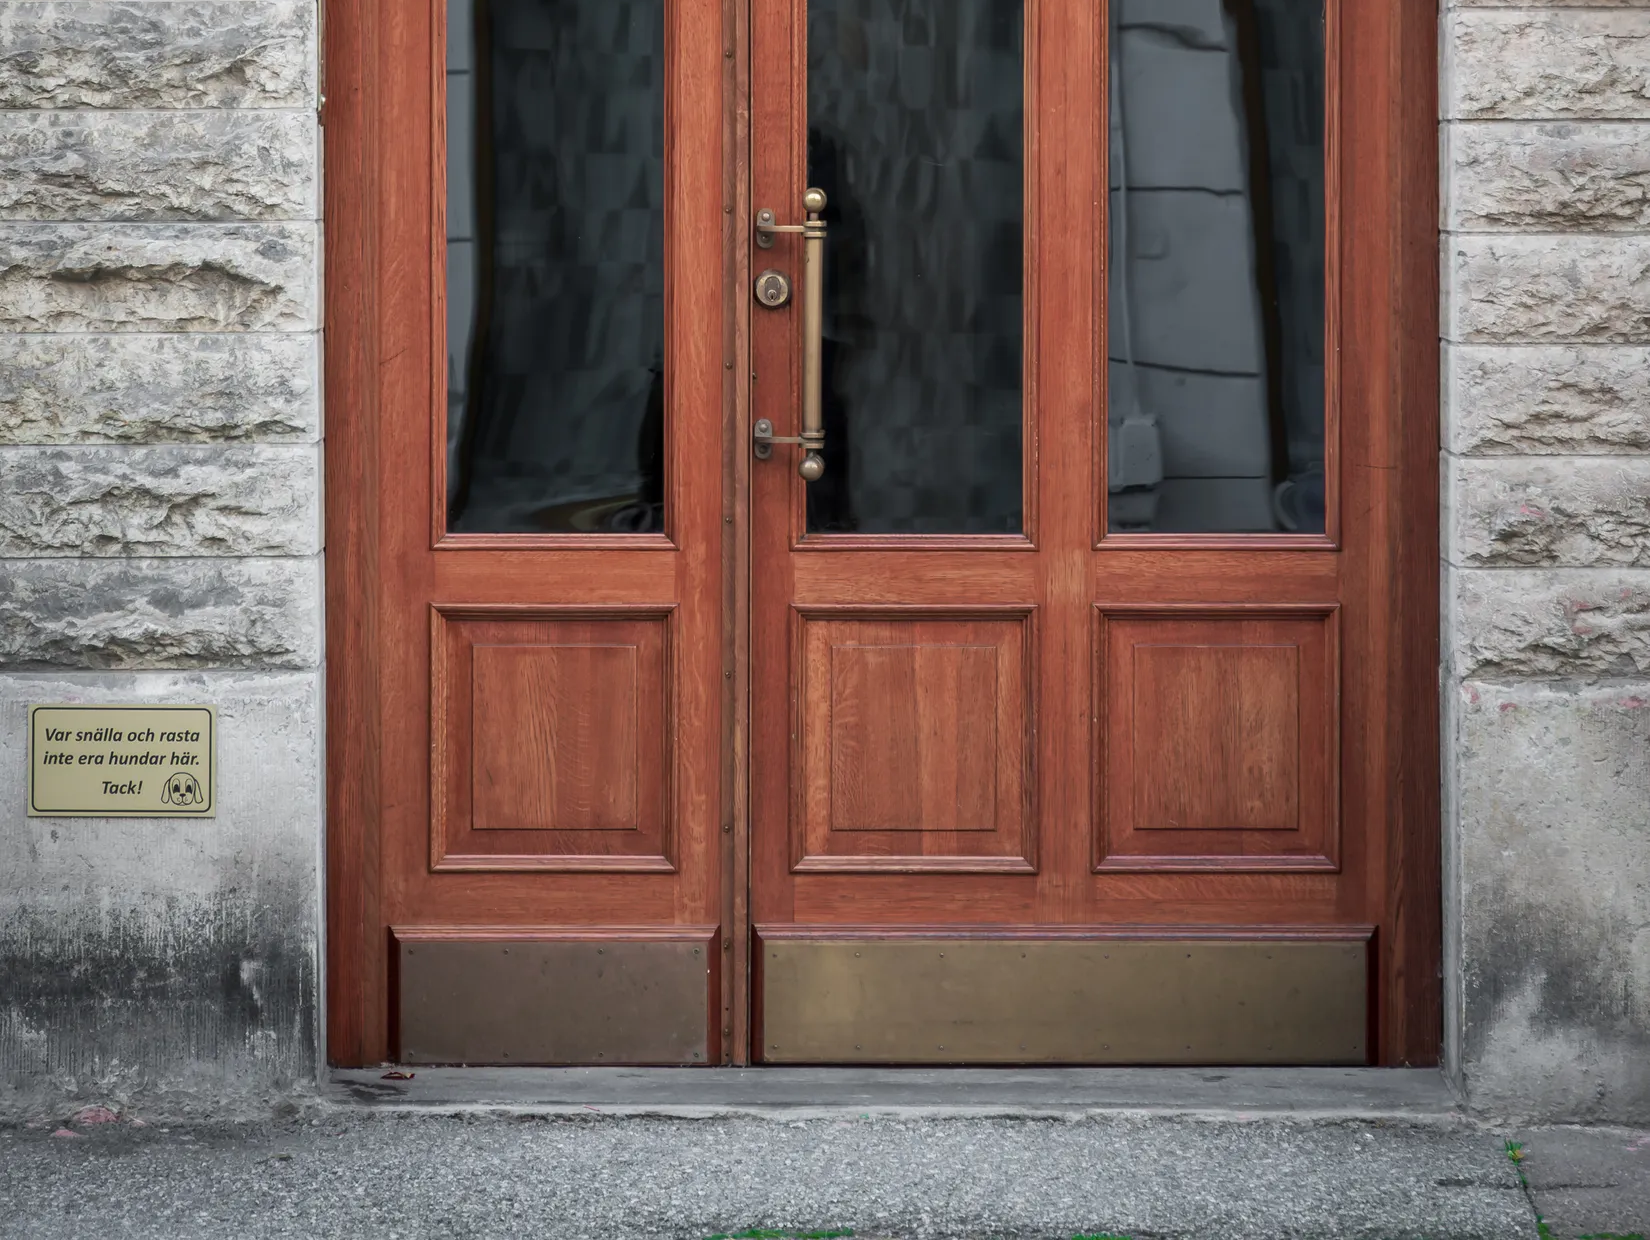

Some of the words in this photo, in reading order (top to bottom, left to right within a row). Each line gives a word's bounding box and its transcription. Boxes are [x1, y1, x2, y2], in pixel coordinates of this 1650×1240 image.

[45, 728, 72, 742] Var
[75, 728, 123, 742] snälla
[127, 728, 155, 742] och
[159, 730, 200, 742] rasta
[43, 751, 73, 765] inte
[78, 754, 104, 765] era
[108, 751, 166, 765] hundar
[170, 752, 200, 766] här.
[102, 780, 143, 795] Tack!
